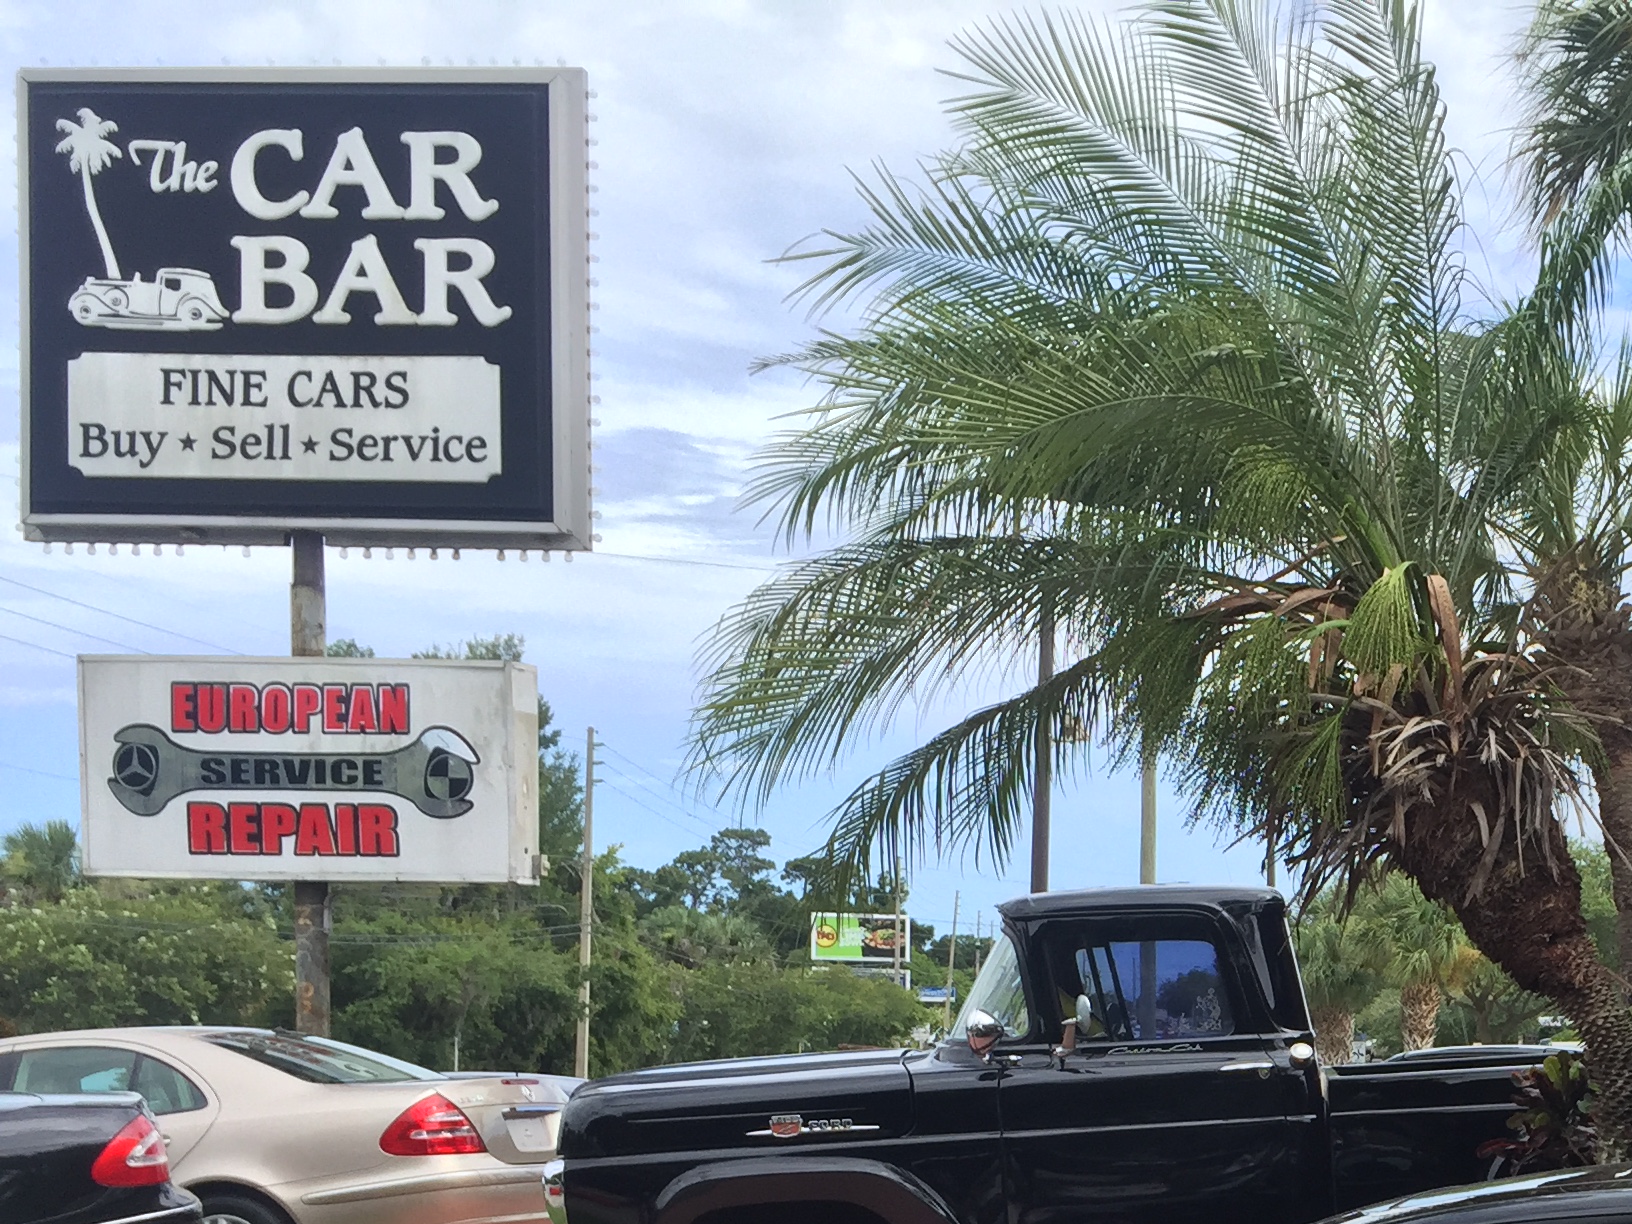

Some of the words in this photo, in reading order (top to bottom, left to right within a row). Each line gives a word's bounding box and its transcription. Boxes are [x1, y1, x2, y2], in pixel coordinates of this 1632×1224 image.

[128, 139, 219, 193] The
[230, 127, 499, 221] CAR
[230, 234, 512, 327] BAR
[160, 368, 269, 408] FINE
[287, 370, 410, 410] CARS
[79, 423, 168, 468] Buy
[211, 423, 292, 462] Sell
[328, 426, 488, 464] Service
[170, 681, 410, 735] EUROPEAN
[200, 758, 384, 786] SERVICE
[187, 802, 400, 857] REPAIR
[808, 1118, 853, 1131] FORD
